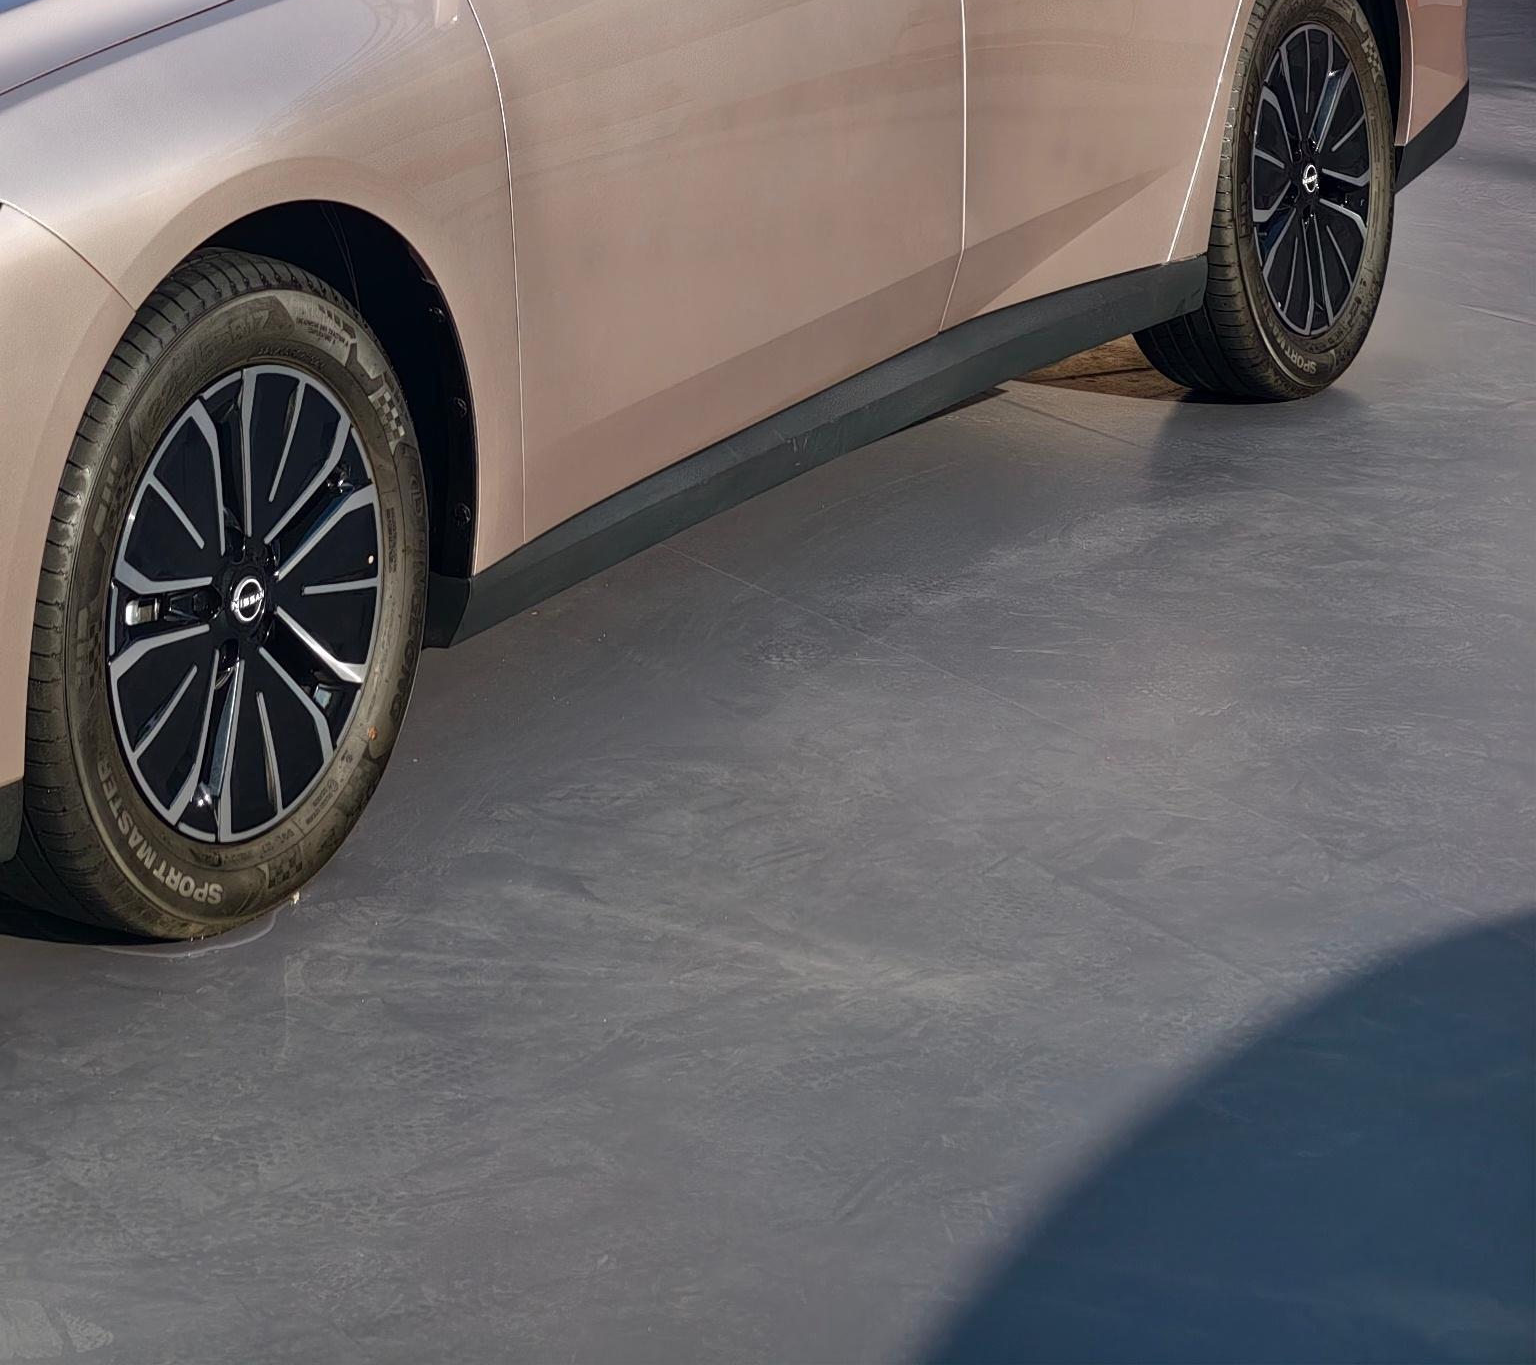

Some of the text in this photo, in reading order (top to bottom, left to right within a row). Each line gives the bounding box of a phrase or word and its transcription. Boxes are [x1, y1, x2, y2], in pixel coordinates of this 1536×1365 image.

[1284, 345, 1317, 374] SPORT
[96, 759, 158, 870] MASTER
[152, 861, 225, 905] SPORT
